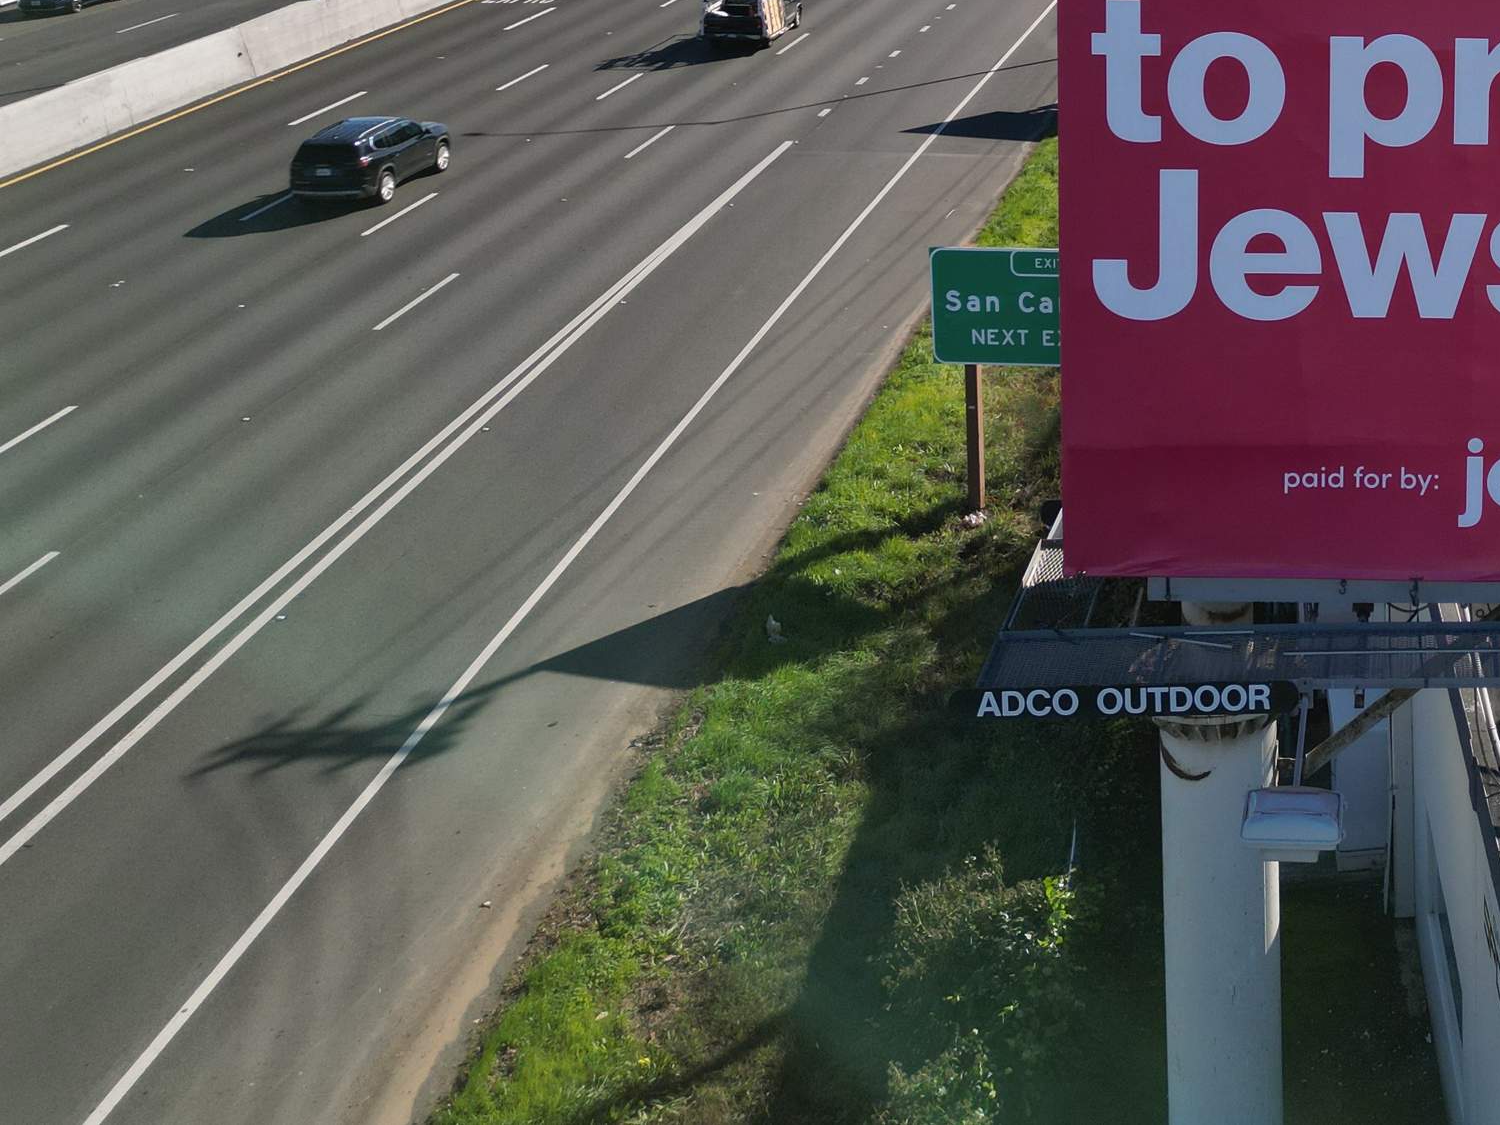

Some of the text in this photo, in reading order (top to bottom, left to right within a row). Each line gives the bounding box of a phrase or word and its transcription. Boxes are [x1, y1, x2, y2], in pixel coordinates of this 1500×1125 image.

[945, 289, 1000, 312] San
[971, 329, 1029, 345] NEXT
[1283, 465, 1345, 494] paid
[1352, 465, 1393, 489] for
[1399, 466, 1440, 497] by:
[976, 683, 1271, 718] ADCO OUTDOOR
